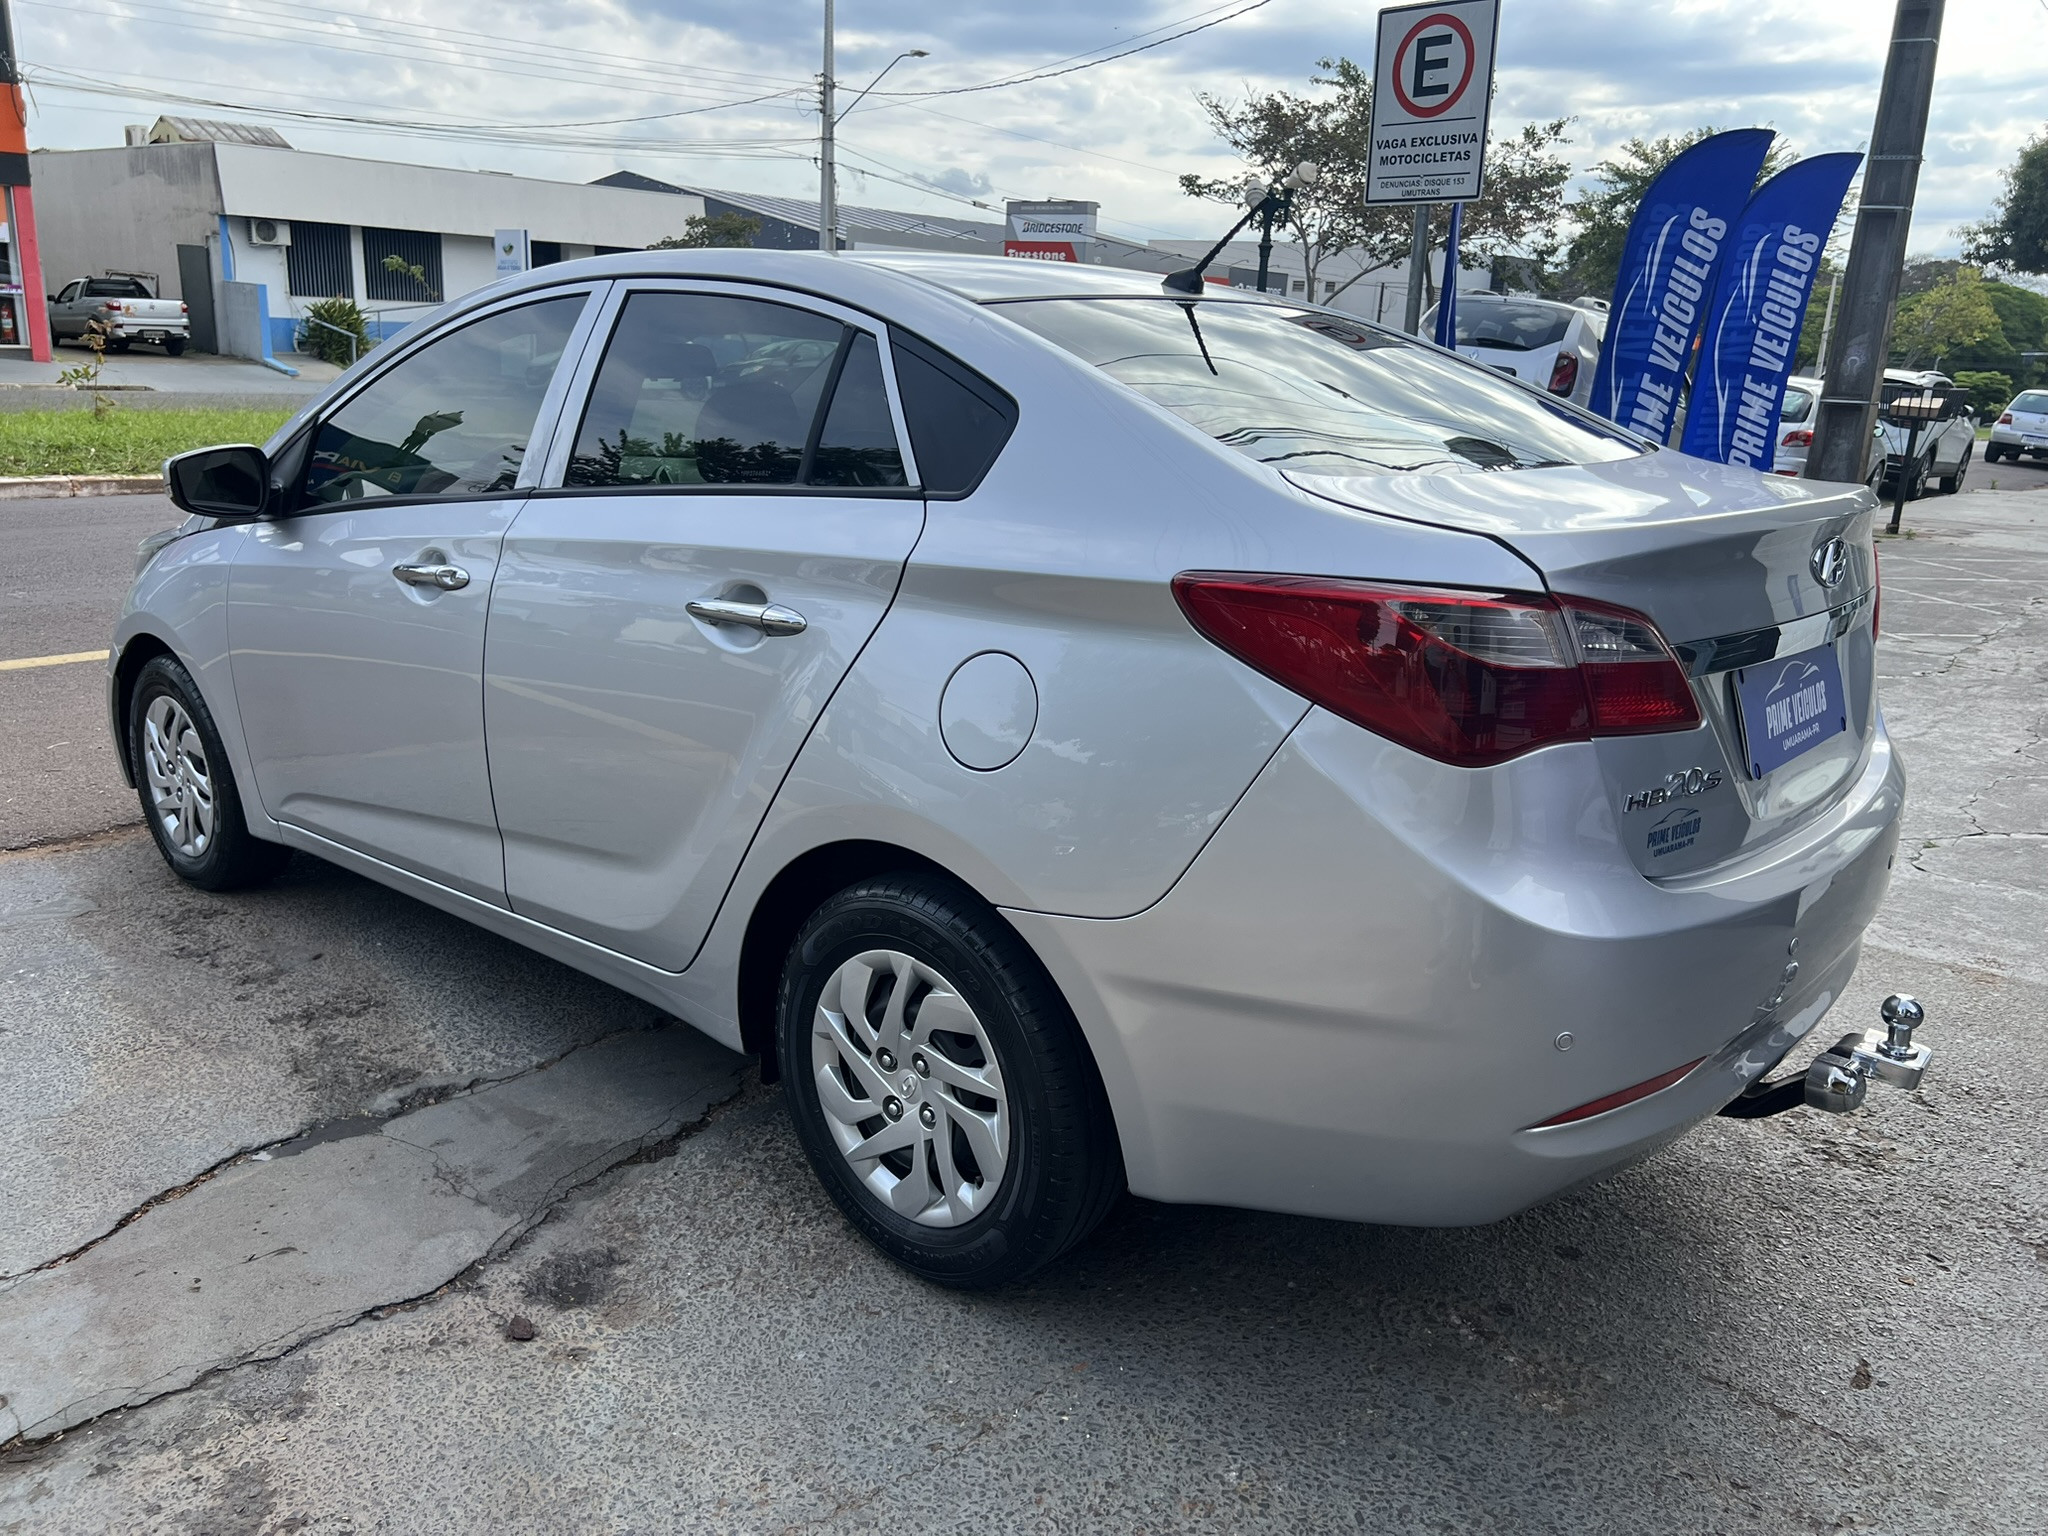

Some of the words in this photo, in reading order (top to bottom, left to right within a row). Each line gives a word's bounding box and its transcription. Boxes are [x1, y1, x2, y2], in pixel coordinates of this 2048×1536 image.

[1413, 34, 1452, 98] E
[1377, 138, 1407, 150] VAGA
[1410, 133, 1478, 147] EXCLUSIVA
[1379, 150, 1471, 166] MOTOCICLETAS
[1380, 180, 1423, 189] DENUNCIAS:
[1424, 178, 1451, 187] DISQUE
[1453, 177, 1465, 185] 153
[1401, 188, 1440, 197] UMUTRANS
[1022, 221, 1083, 233] BRIDGESTONE
[1007, 248, 1066, 260] Firestone
[1648, 206, 1727, 372] VEÍCULOS
[1749, 224, 1820, 373] VEÍCULOS
[1766, 697, 1793, 739] PRIME
[1791, 680, 1827, 725] VEÍCULOS
[1783, 722, 1820, 751] UMUARAMA-PR
[1647, 827, 1670, 849] PRIME
